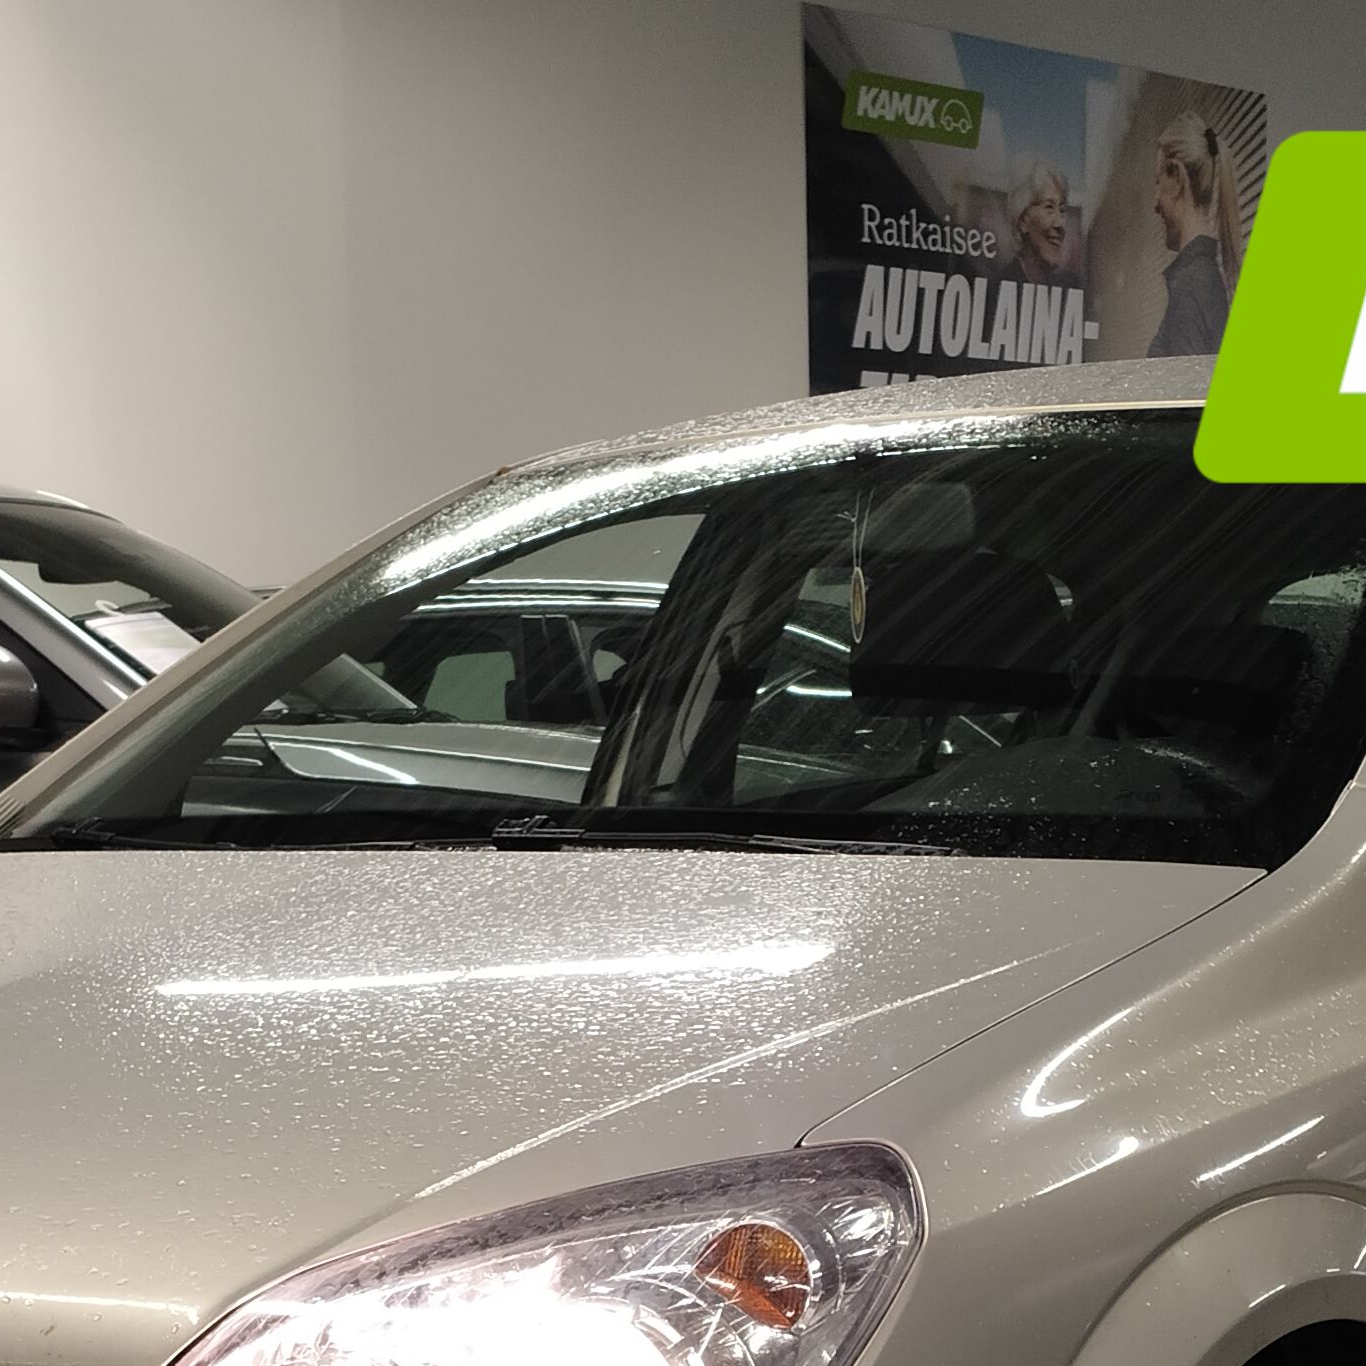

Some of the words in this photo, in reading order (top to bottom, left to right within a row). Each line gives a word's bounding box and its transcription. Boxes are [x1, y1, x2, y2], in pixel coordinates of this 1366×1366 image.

[857, 86, 939, 129] KAMUX
[861, 204, 997, 259] Ratkaisee
[852, 264, 1099, 365] AUTOLAINA-
